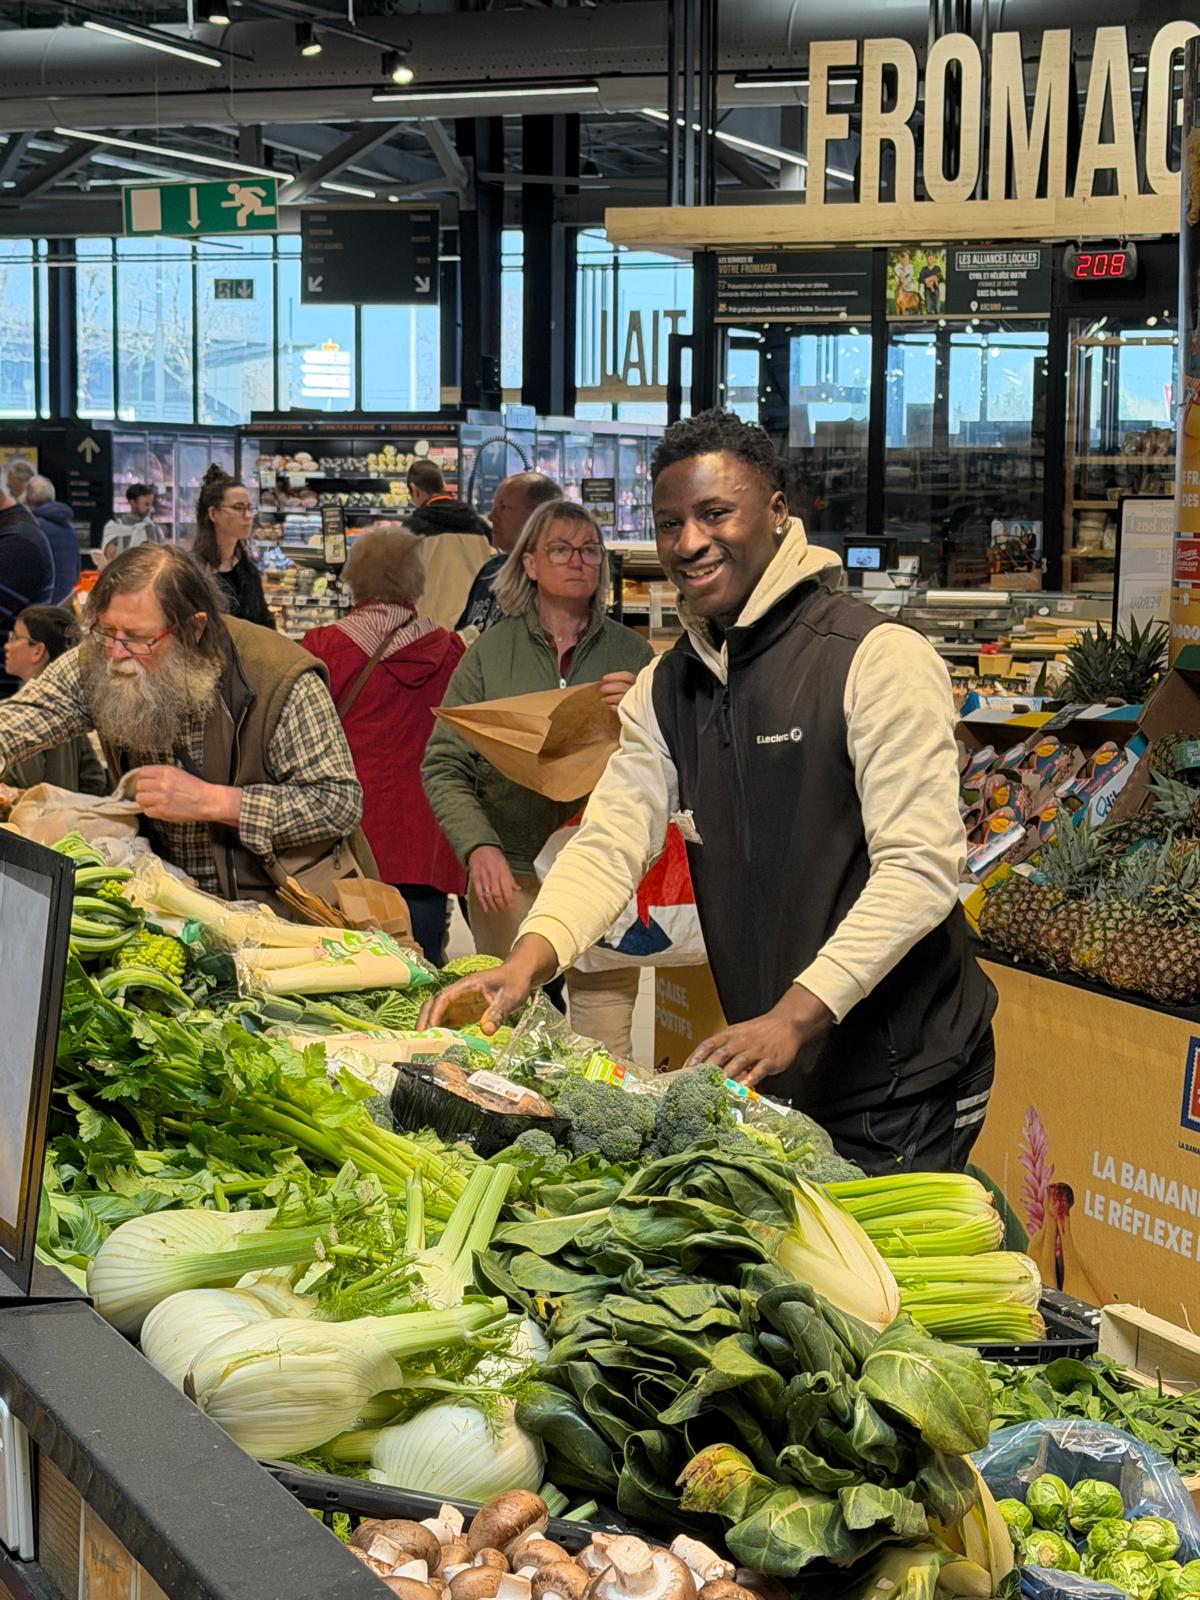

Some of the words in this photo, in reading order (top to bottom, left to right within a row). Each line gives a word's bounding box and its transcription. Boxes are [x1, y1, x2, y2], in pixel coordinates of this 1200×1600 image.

[718, 264, 740, 274] VOTRE
[740, 263, 777, 273] FROMAGER
[958, 254, 971, 265] LES
[972, 253, 1007, 265] ALLIANCES
[1008, 252, 1038, 264] LOCALES
[1074, 253, 1126, 277] 208
[1092, 1151, 1117, 1184] LA
[1120, 1161, 1200, 1217] BANAN
[1084, 1189, 1105, 1221] LE
[1108, 1198, 1193, 1258] RÉFLEXE
